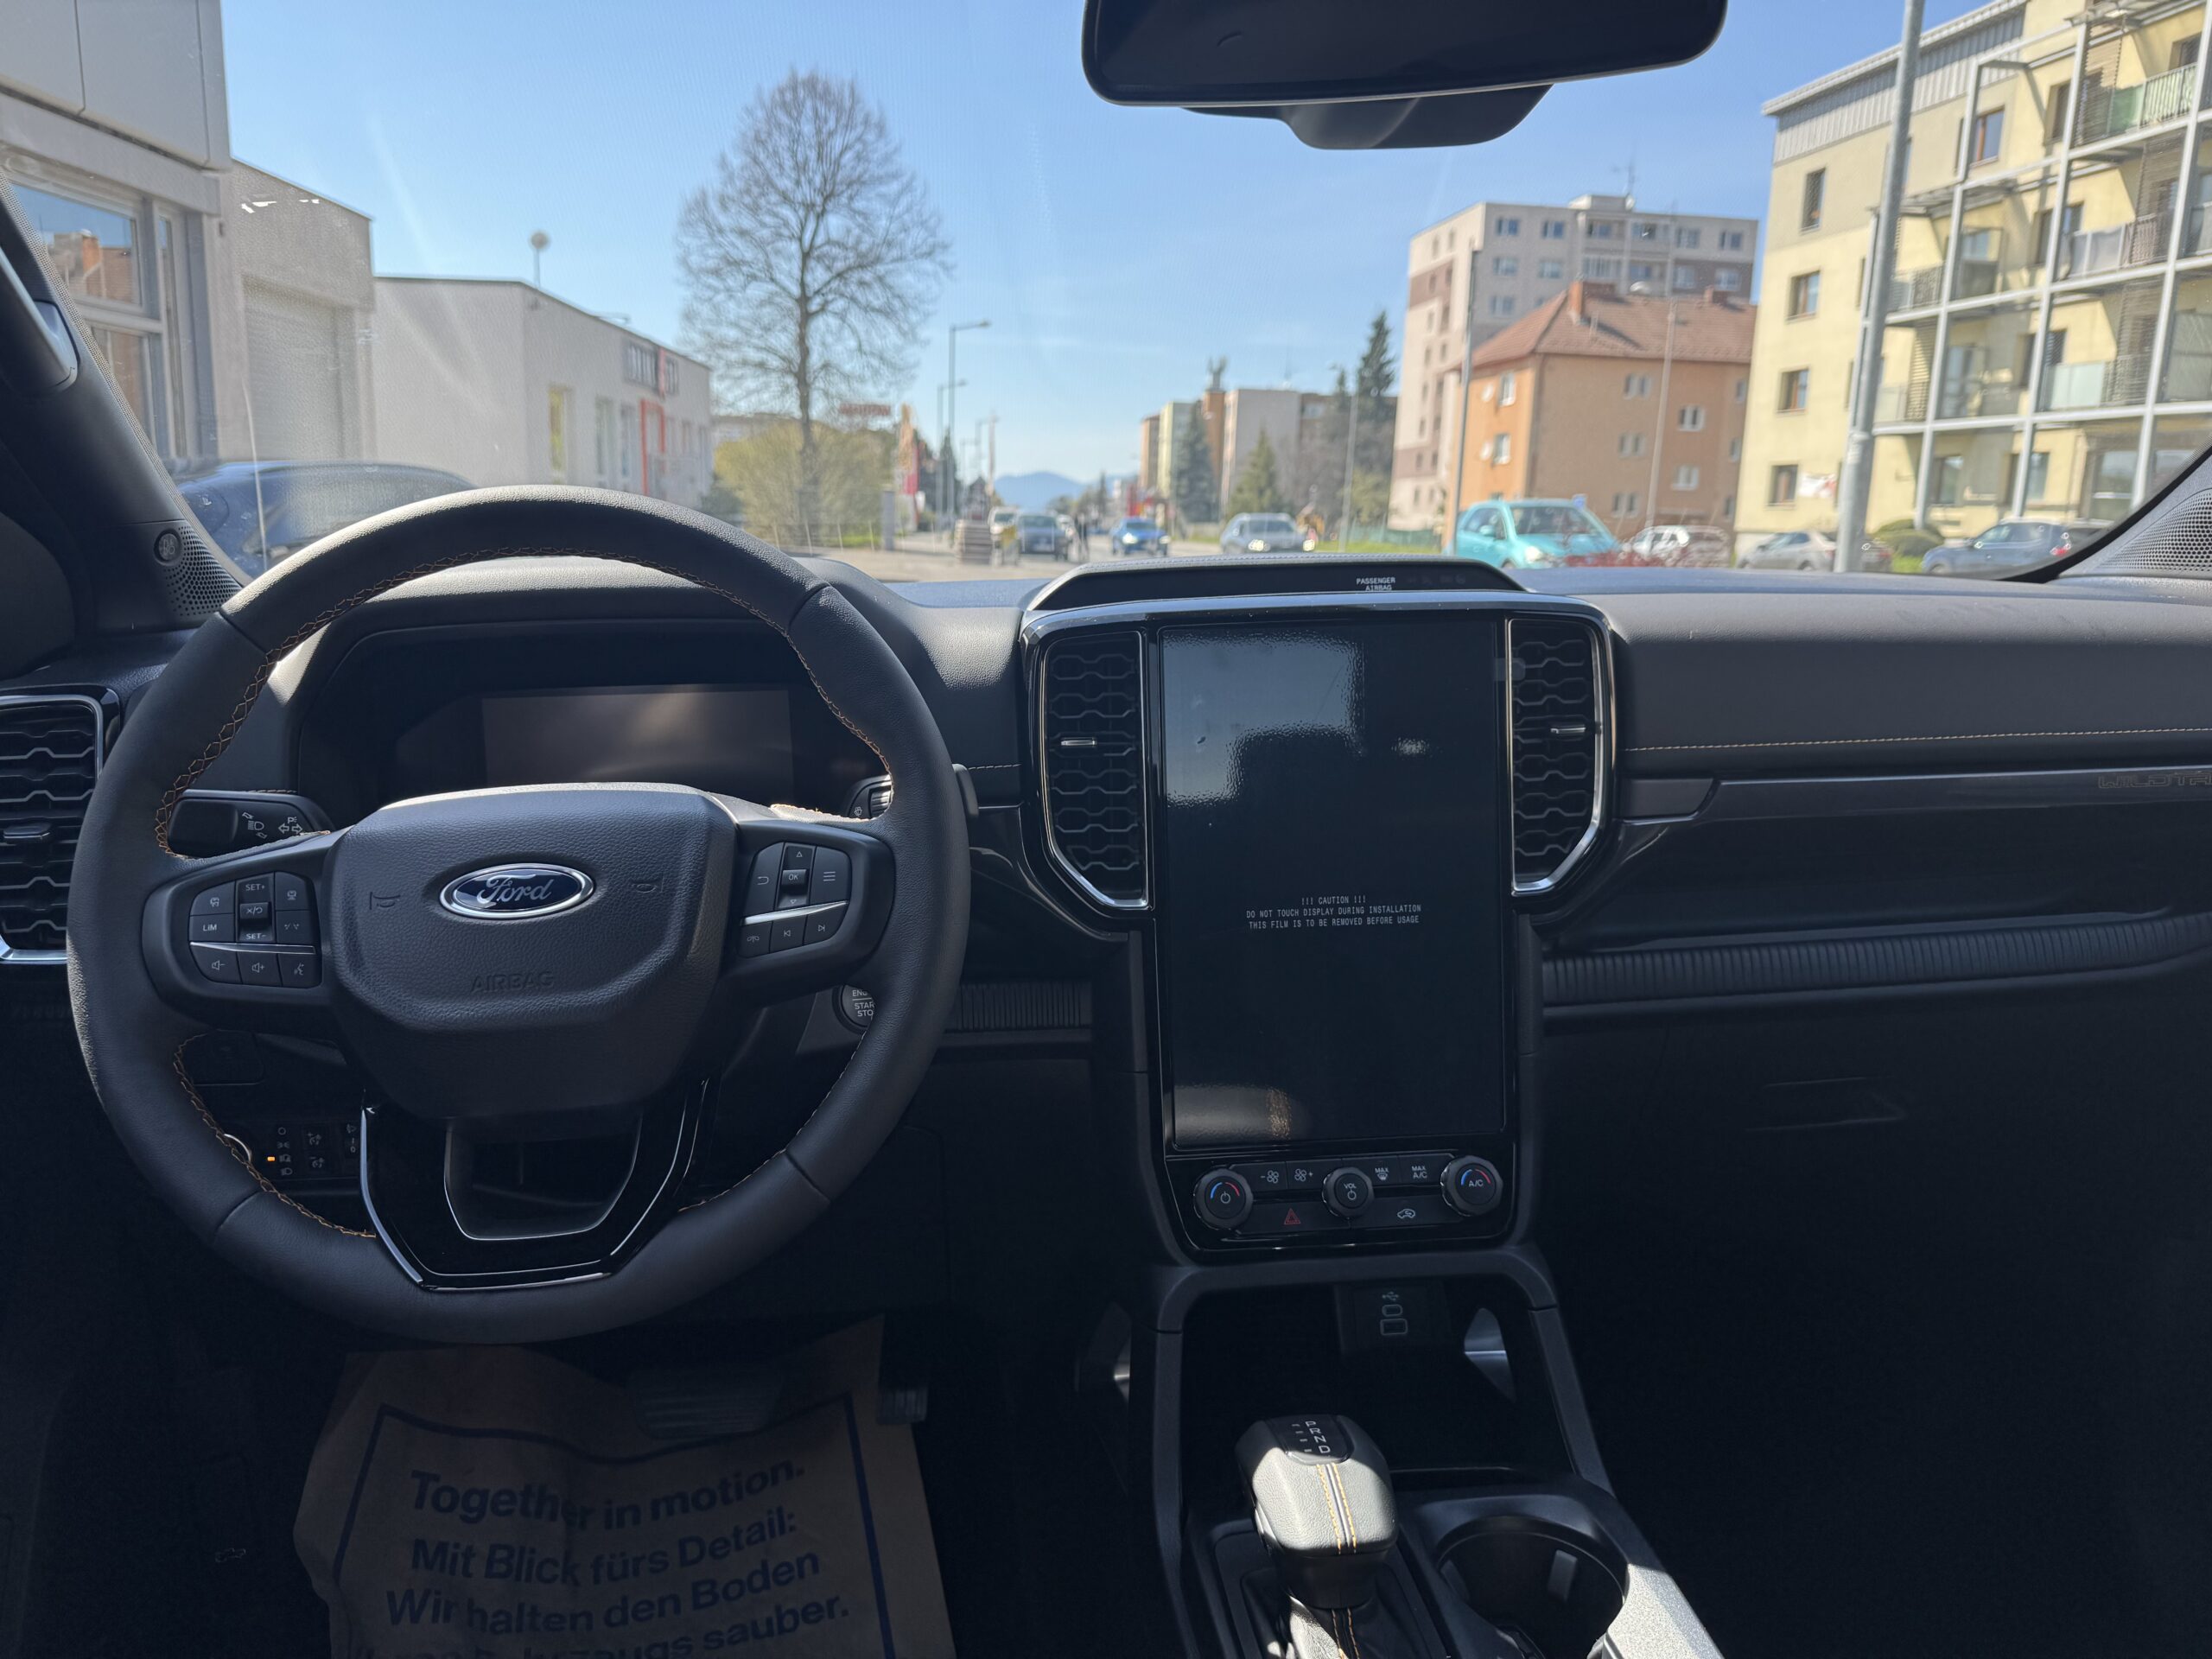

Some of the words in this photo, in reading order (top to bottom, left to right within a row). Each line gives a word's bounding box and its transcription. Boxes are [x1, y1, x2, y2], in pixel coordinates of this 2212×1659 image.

[1356, 576, 1395, 585] PASSENGER
[476, 874, 554, 905] Ford
[1318, 895, 1349, 905] CAUTION
[1246, 910, 1255, 918] DO
[1303, 907, 1334, 916] DISPLAY
[1338, 906, 1365, 915] DURING
[1369, 904, 1421, 914] INSTALLATION
[1249, 920, 1267, 929] THIS
[1270, 920, 1288, 929] FILM
[1293, 919, 1301, 928] IS
[1306, 918, 1314, 927] TO
[1319, 918, 1327, 927] BE
[1332, 917, 1363, 926] REMOVED
[1367, 916, 1393, 925] BEFORE
[1397, 915, 1420, 924] USAGE
[470, 970, 556, 994] AIRBAG
[1413, 1171, 1427, 1179] A/C
[1468, 1179, 1484, 1187] A/C
[1319, 1445, 1331, 1453] D
[410, 1469, 595, 1529] Together
[603, 1497, 640, 1530] in
[651, 1459, 805, 1520] motion.
[411, 1539, 473, 1578] Mit
[484, 1543, 581, 1587] Blick
[590, 1548, 669, 1586] fürs
[677, 1505, 796, 1568] Detail:
[386, 1588, 458, 1625] Wir
[467, 1598, 594, 1635] halten
[603, 1592, 681, 1628] den
[691, 1551, 820, 1611] Boden
[702, 1594, 849, 1651] sauber.
